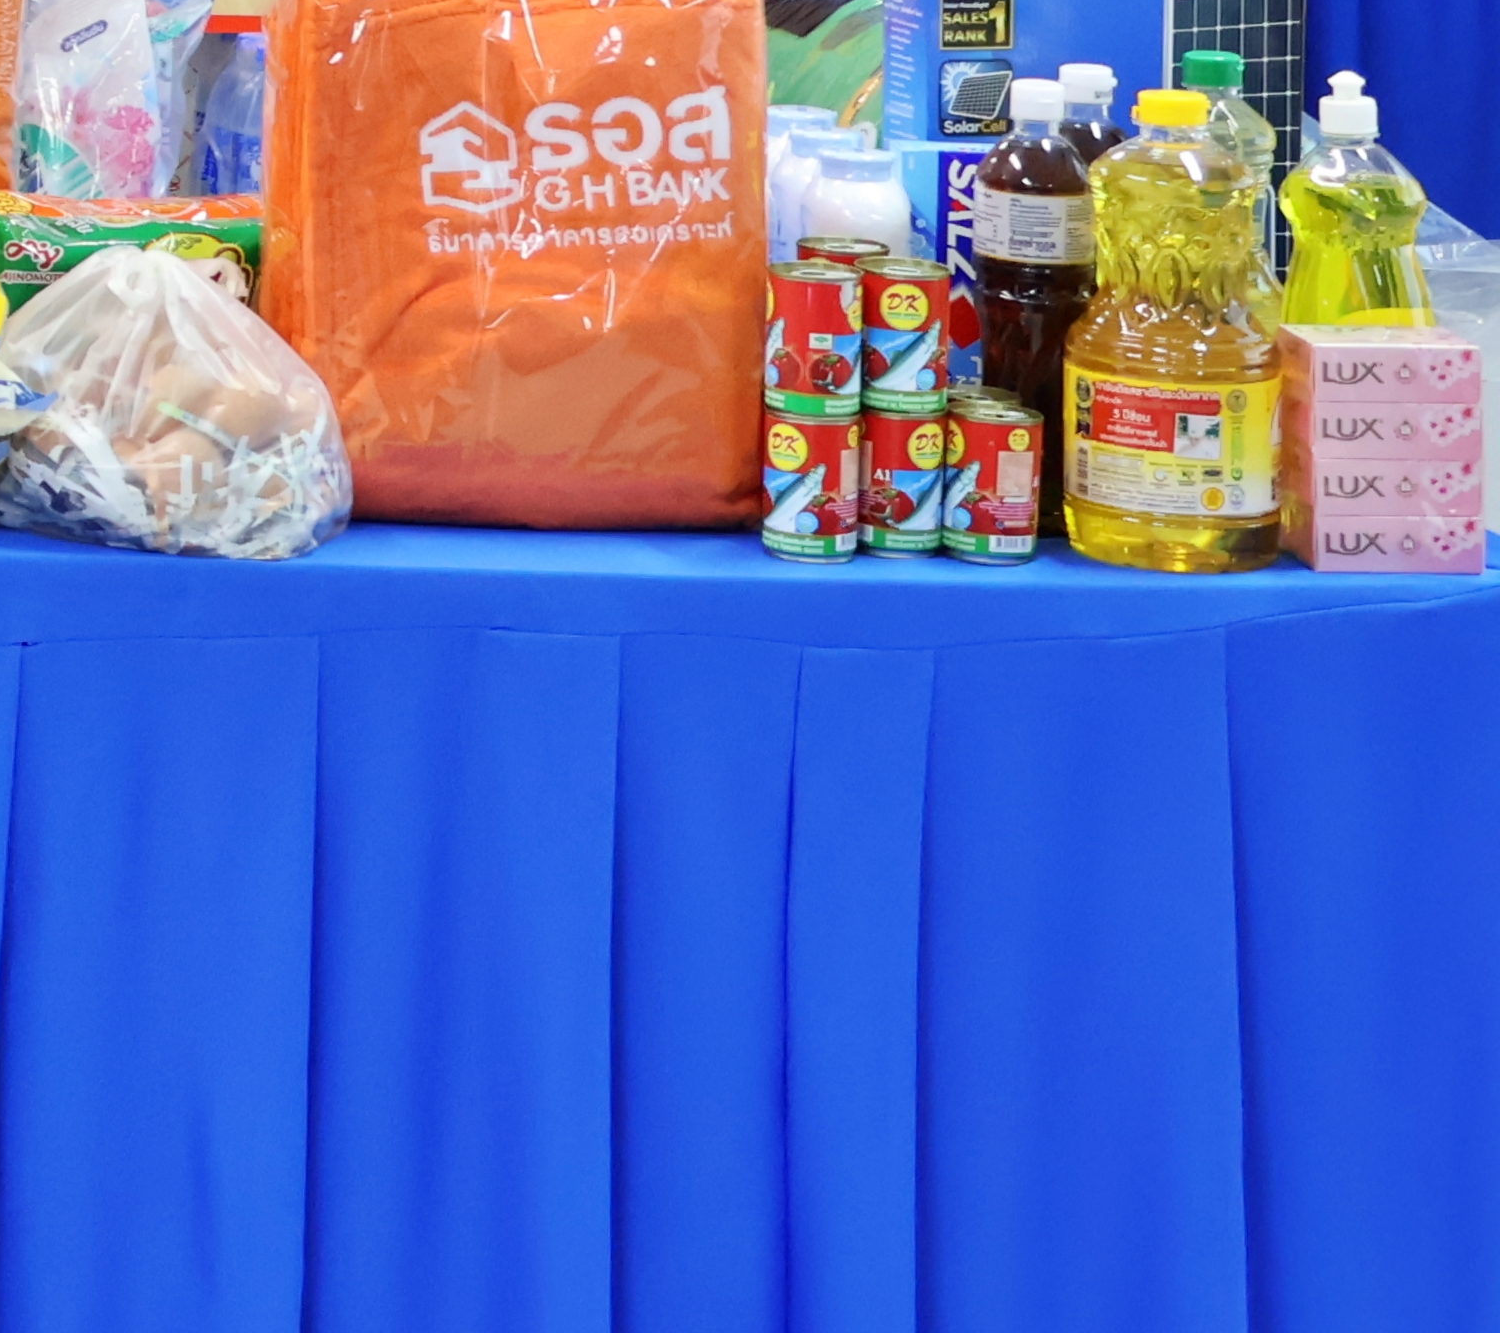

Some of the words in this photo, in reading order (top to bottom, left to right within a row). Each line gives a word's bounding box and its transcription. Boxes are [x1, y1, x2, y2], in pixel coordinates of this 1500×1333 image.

[942, 11, 988, 25] SALES
[943, 29, 987, 43] RANK
[524, 85, 732, 171] ธอส
[626, 167, 731, 207] BANK
[886, 292, 922, 314] DK
[1321, 361, 1385, 386] LUX
[1321, 417, 1385, 442] LUX
[771, 433, 800, 454] DK
[915, 432, 942, 454] DK
[1323, 475, 1386, 500] LUX
[1324, 532, 1388, 557] LUX
